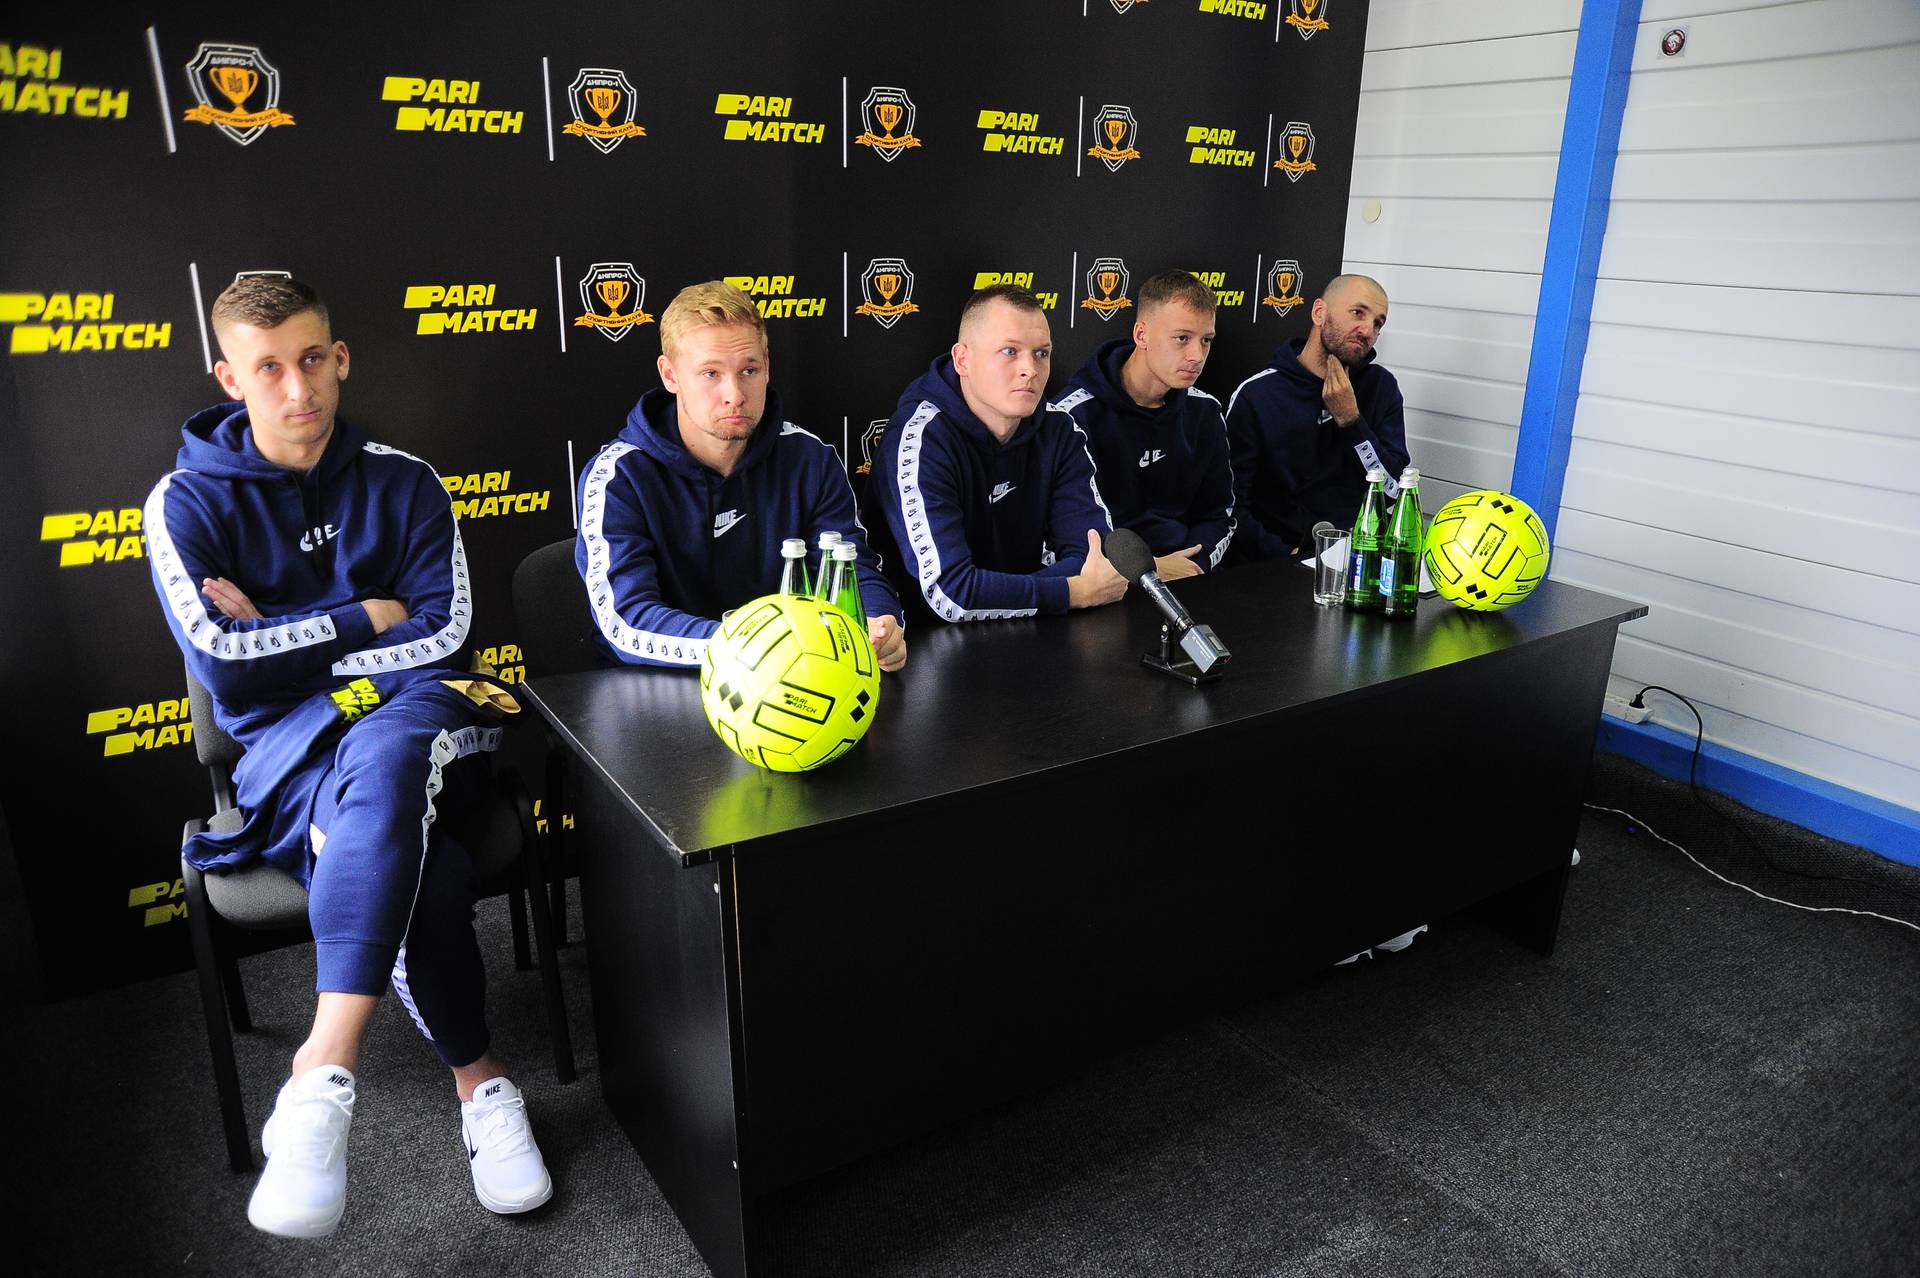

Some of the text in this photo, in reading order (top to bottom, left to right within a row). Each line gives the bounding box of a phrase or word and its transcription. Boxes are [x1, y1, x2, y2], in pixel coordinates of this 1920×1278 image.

[1211, 0, 1266, 20] MATCH
[405, 78, 480, 104] PARI
[735, 95, 792, 117] PARI
[423, 108, 524, 134] MATCH
[744, 121, 825, 143] MATCH
[993, 111, 1039, 131] PARI
[999, 134, 1064, 155] MATCH
[1198, 127, 1236, 145] PARI
[1202, 148, 1255, 167] MATCH
[23, 293, 114, 321] PARI
[428, 284, 496, 307] PARI
[441, 309, 537, 333] MATCH
[47, 322, 171, 352] MATCH
[443, 471, 511, 495] PARI
[453, 491, 550, 520] MATCH
[72, 508, 144, 537] PAR
[113, 697, 190, 729] PARI
[328, 1074, 351, 1087] NIKE
[485, 1083, 501, 1098] NIKE
